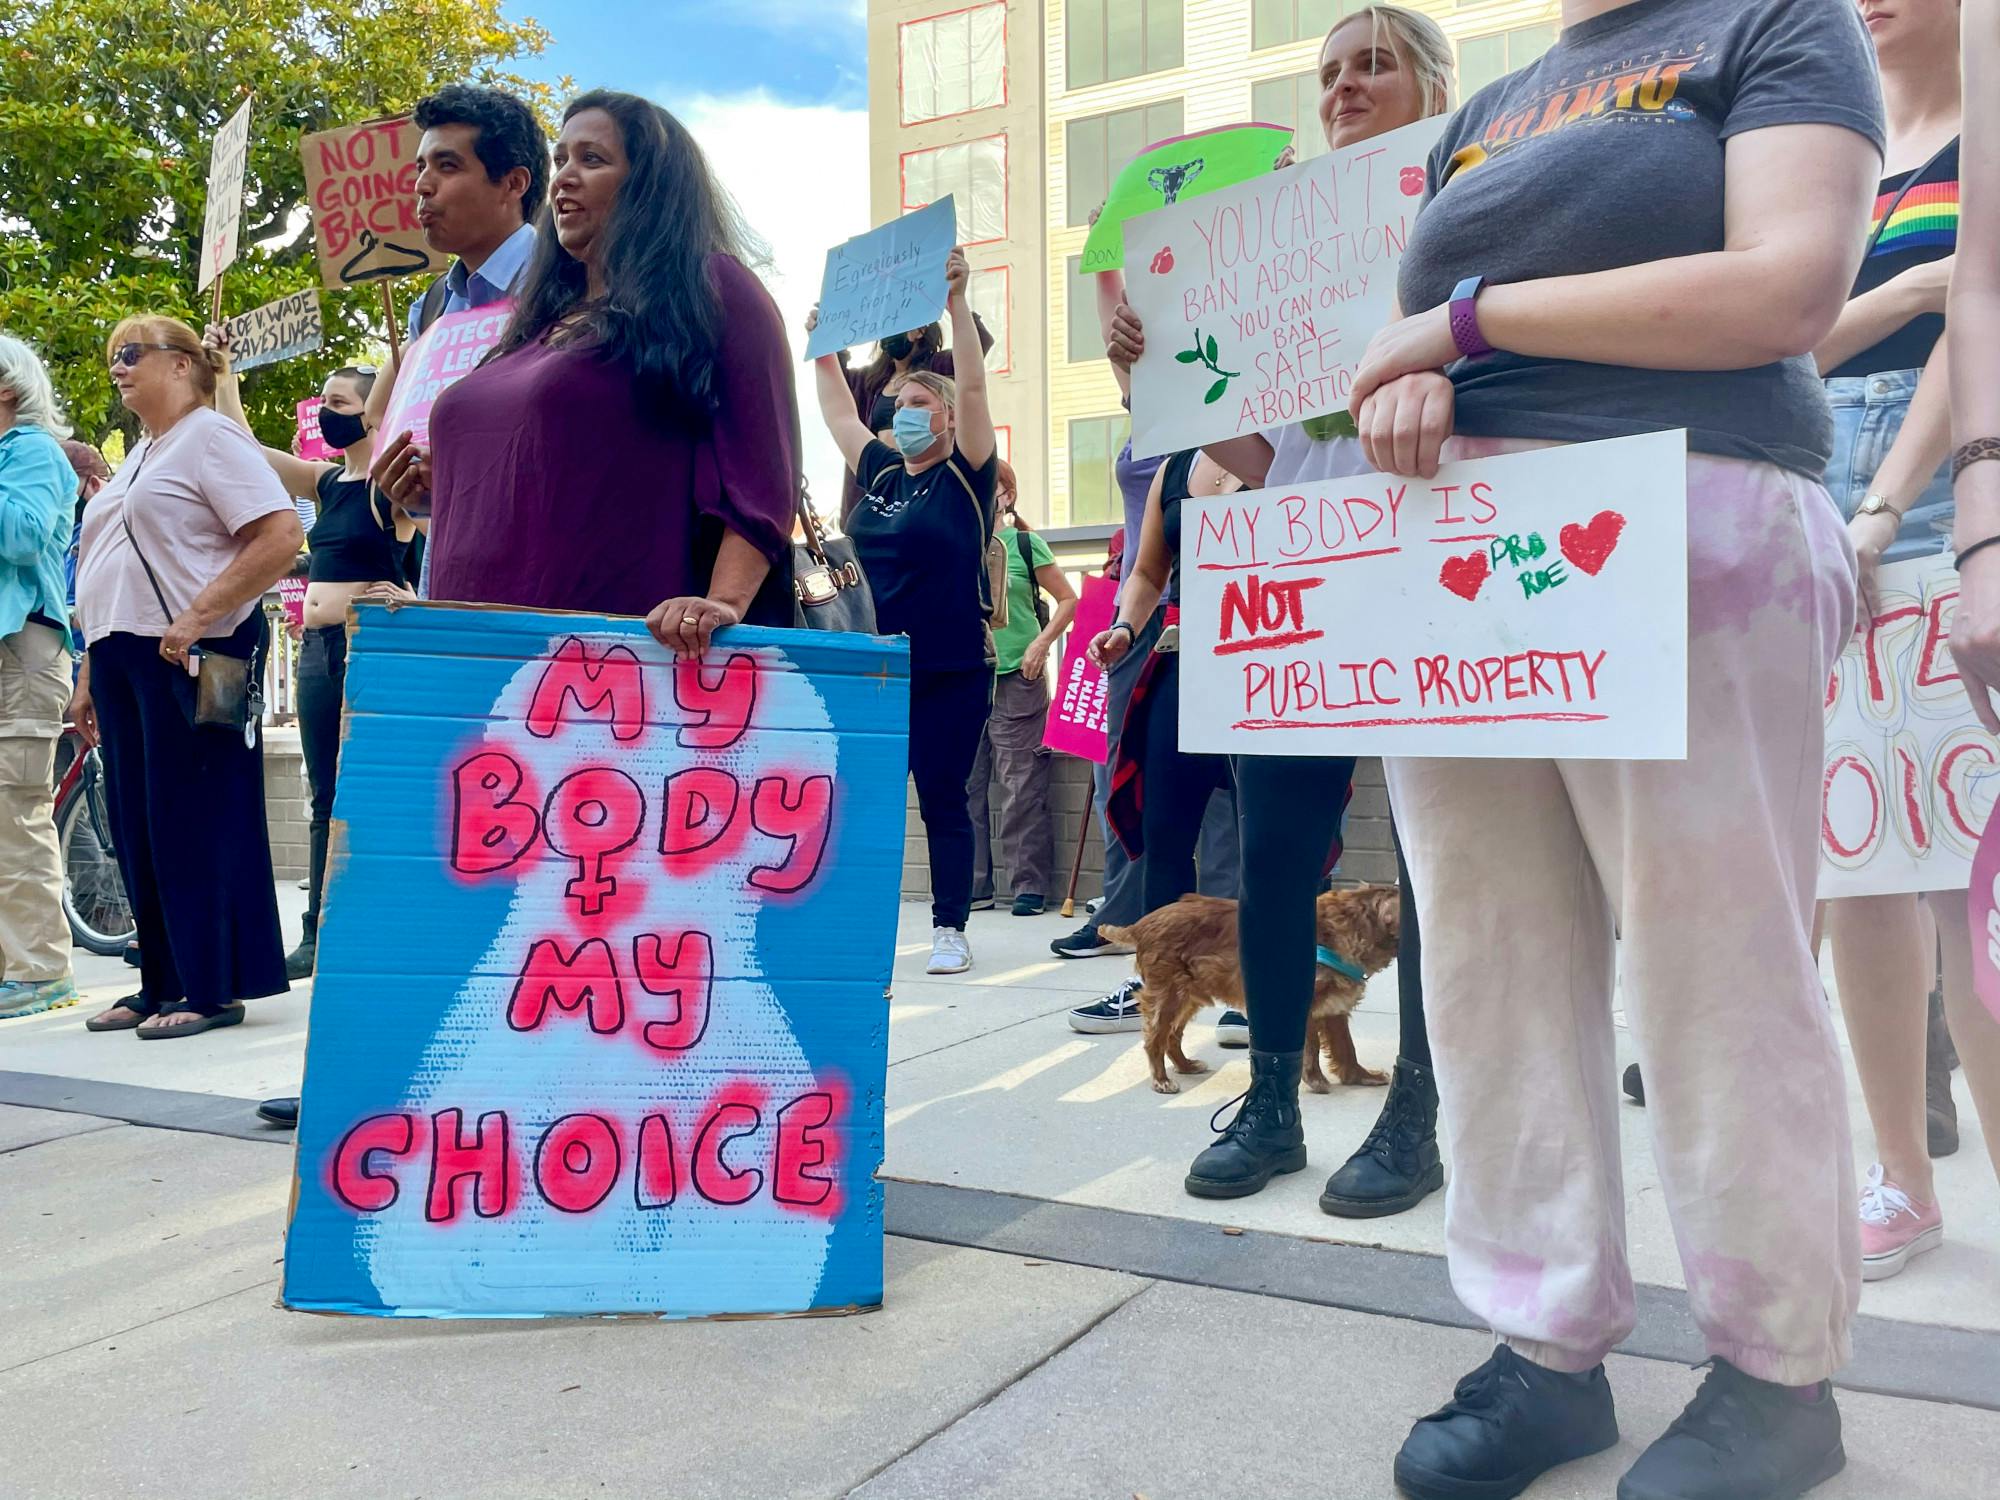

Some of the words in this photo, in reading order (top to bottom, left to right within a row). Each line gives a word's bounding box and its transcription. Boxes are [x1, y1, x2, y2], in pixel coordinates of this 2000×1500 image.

[319, 119, 410, 175] NOT
[316, 163, 416, 211] GOING
[1193, 197, 1262, 280] YOU
[1271, 148, 1387, 249] CAN'T
[319, 199, 422, 258] BACK
[859, 290, 892, 311] from
[901, 279, 927, 298] the
[1183, 271, 1239, 322] BAN
[1256, 216, 1406, 301] ABORTION
[266, 290, 317, 322] WADE
[1230, 306, 1270, 342] YOU
[1278, 288, 1312, 323] CAN
[1319, 275, 1369, 309] ONLY
[1273, 317, 1317, 349] BAN
[230, 324, 278, 364] SAVES
[281, 314, 321, 349] LIVES
[1254, 329, 1342, 394] SAFE
[1236, 366, 1352, 432] ABORTIO
[1196, 506, 1261, 558] MY
[1278, 484, 1407, 558] BODY
[1432, 481, 1497, 525] IS
[1490, 532, 1547, 571] PRO
[1517, 559, 1570, 600] ROE
[1219, 574, 1326, 641] NOT
[526, 635, 757, 748] MY
[1063, 657, 1085, 711] STAND
[1073, 679, 1095, 724] WITH
[1086, 670, 1109, 731] PLANN
[1244, 656, 1401, 718] PUBLIC
[1414, 649, 1607, 708] PROPERTY
[451, 753, 832, 912] BODY
[506, 931, 714, 1051] MY
[333, 1093, 832, 1223] CHOICE
